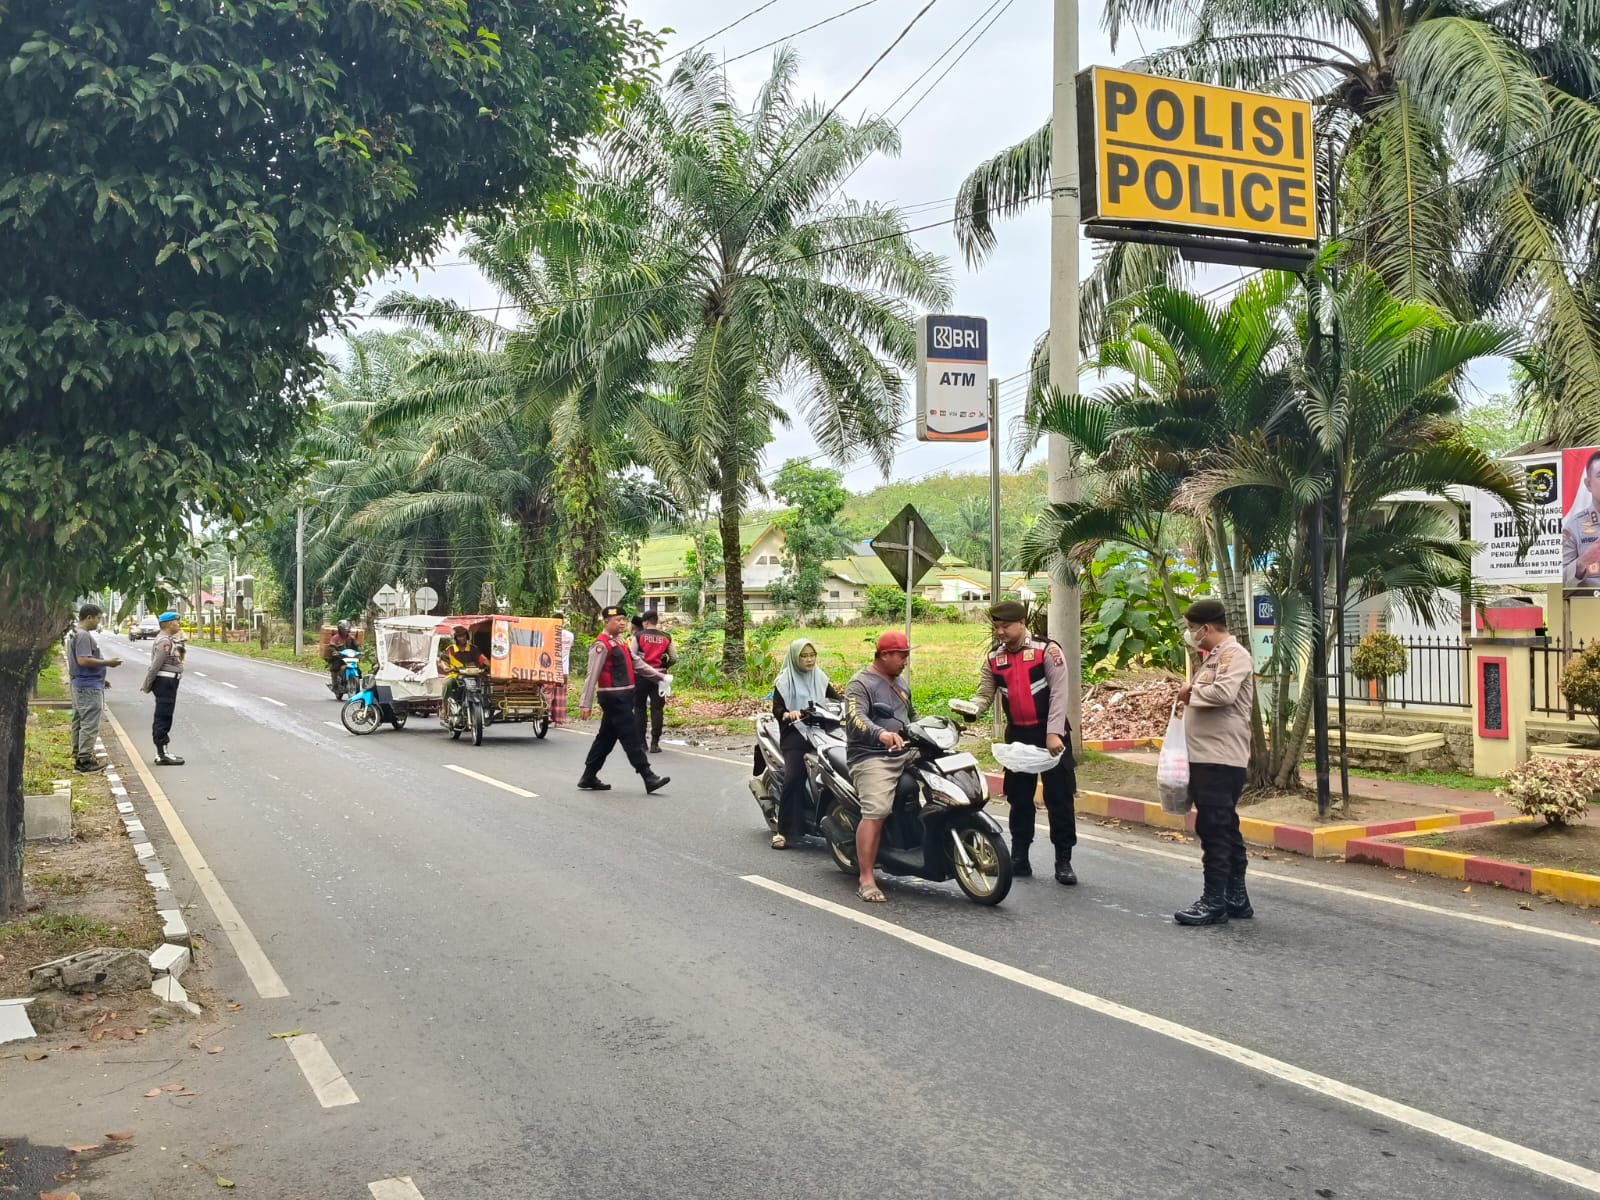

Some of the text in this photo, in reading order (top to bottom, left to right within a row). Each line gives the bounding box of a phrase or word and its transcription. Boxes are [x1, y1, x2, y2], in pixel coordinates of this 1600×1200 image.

[1104, 80, 1304, 160] POLISI
[1107, 152, 1307, 227] POLICE
[953, 329, 979, 349] BRI
[939, 371, 976, 387] ATM
[1530, 548, 1560, 556] CABANG
[644, 635, 664, 644] POLISI
[1262, 635, 1274, 644] AT
